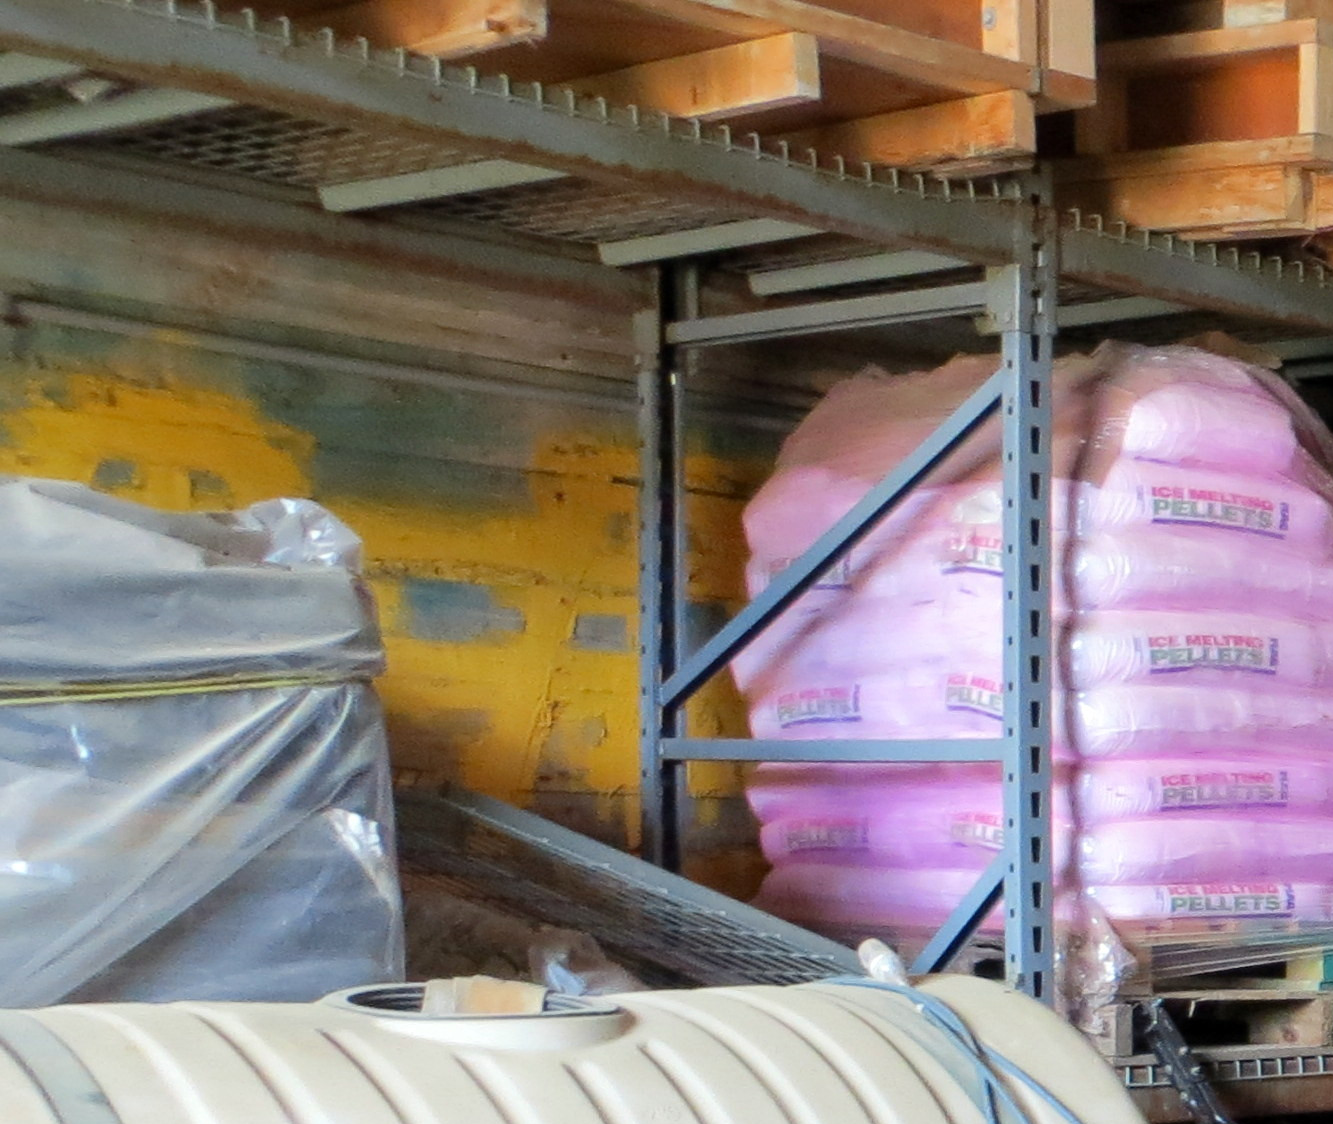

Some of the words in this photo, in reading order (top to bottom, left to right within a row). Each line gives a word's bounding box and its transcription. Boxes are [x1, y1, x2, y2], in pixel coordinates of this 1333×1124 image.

[1152, 486, 1185, 499] ICE
[1189, 489, 1274, 512] MELTING
[1153, 499, 1274, 528] PELLETS
[1186, 635, 1264, 648] MELTING
[1151, 647, 1264, 666] PELLETS
[777, 697, 850, 722] PELLETS
[1161, 774, 1191, 787] ICE
[1162, 784, 1274, 805] PELLETS
[1170, 894, 1282, 913] PELLETS
